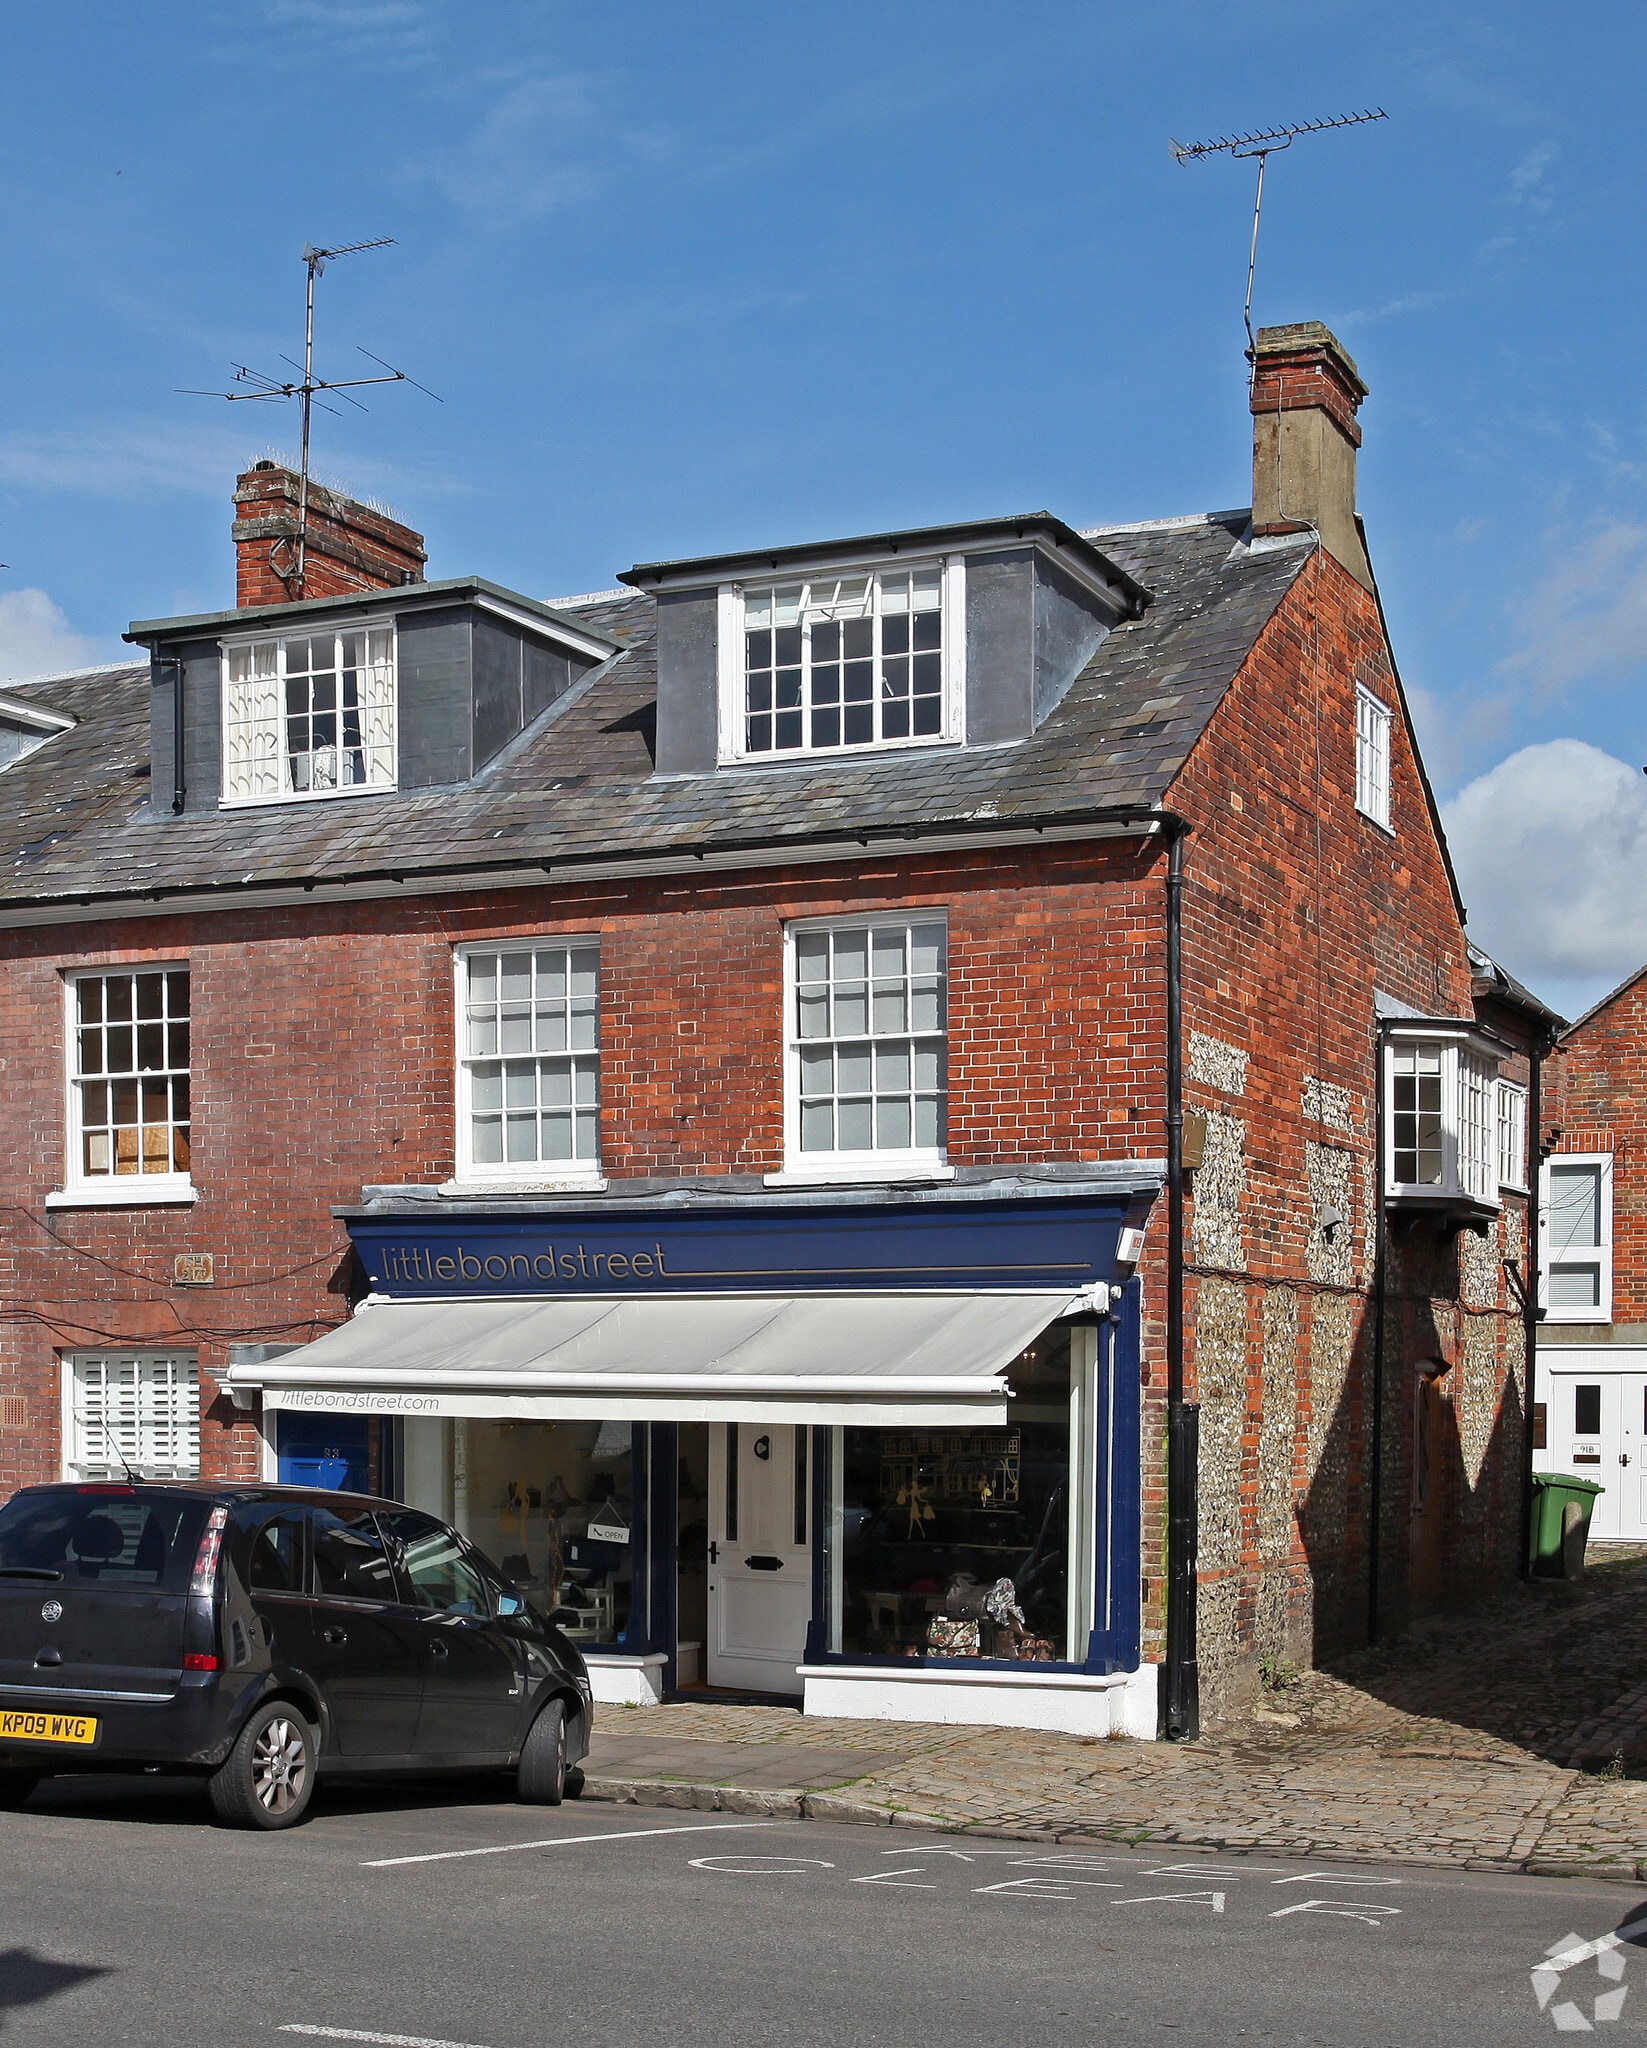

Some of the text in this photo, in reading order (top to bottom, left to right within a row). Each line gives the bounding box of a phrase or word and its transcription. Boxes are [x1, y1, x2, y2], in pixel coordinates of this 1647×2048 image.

[381, 1243, 667, 1282] littlebondstreet
[281, 1390, 440, 1411] littlebondstreet.com
[1579, 1445, 1595, 1454] 91B
[604, 1530, 624, 1540] OPEN
[2, 1713, 87, 1739] KP09 WVG
[881, 1844, 1402, 1887] KEEP
[687, 1855, 1403, 1927] CLEAR
